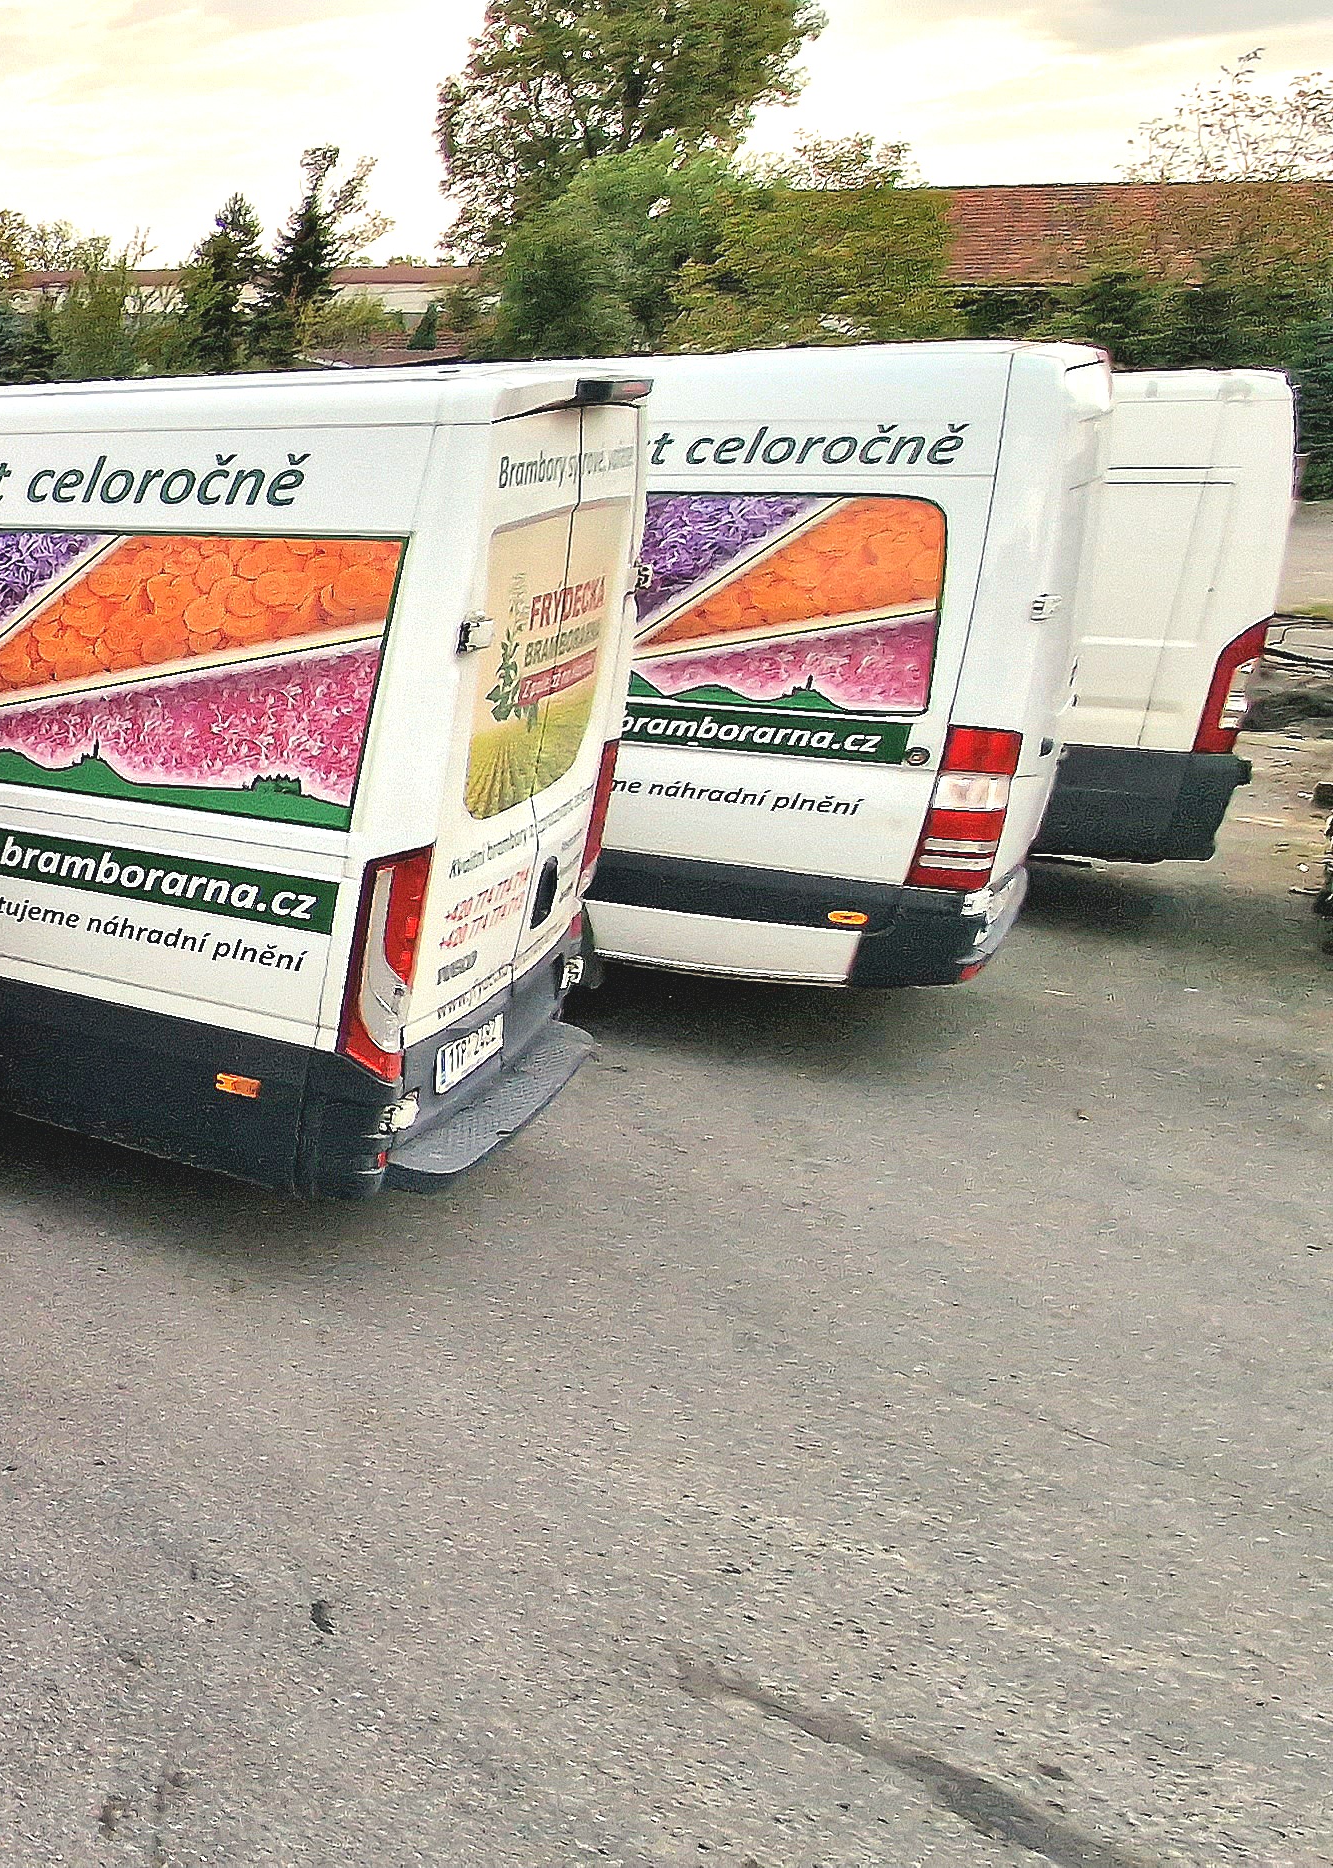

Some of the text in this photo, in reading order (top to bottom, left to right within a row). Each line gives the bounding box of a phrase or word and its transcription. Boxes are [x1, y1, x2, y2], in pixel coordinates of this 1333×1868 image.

[685, 422, 971, 469] celoročně
[26, 452, 312, 507] celoročně
[498, 450, 567, 489] Brambory
[647, 781, 770, 808] náhradní
[771, 792, 867, 818] plnění
[86, 915, 209, 956] náhradní
[213, 938, 307, 974] plnění
